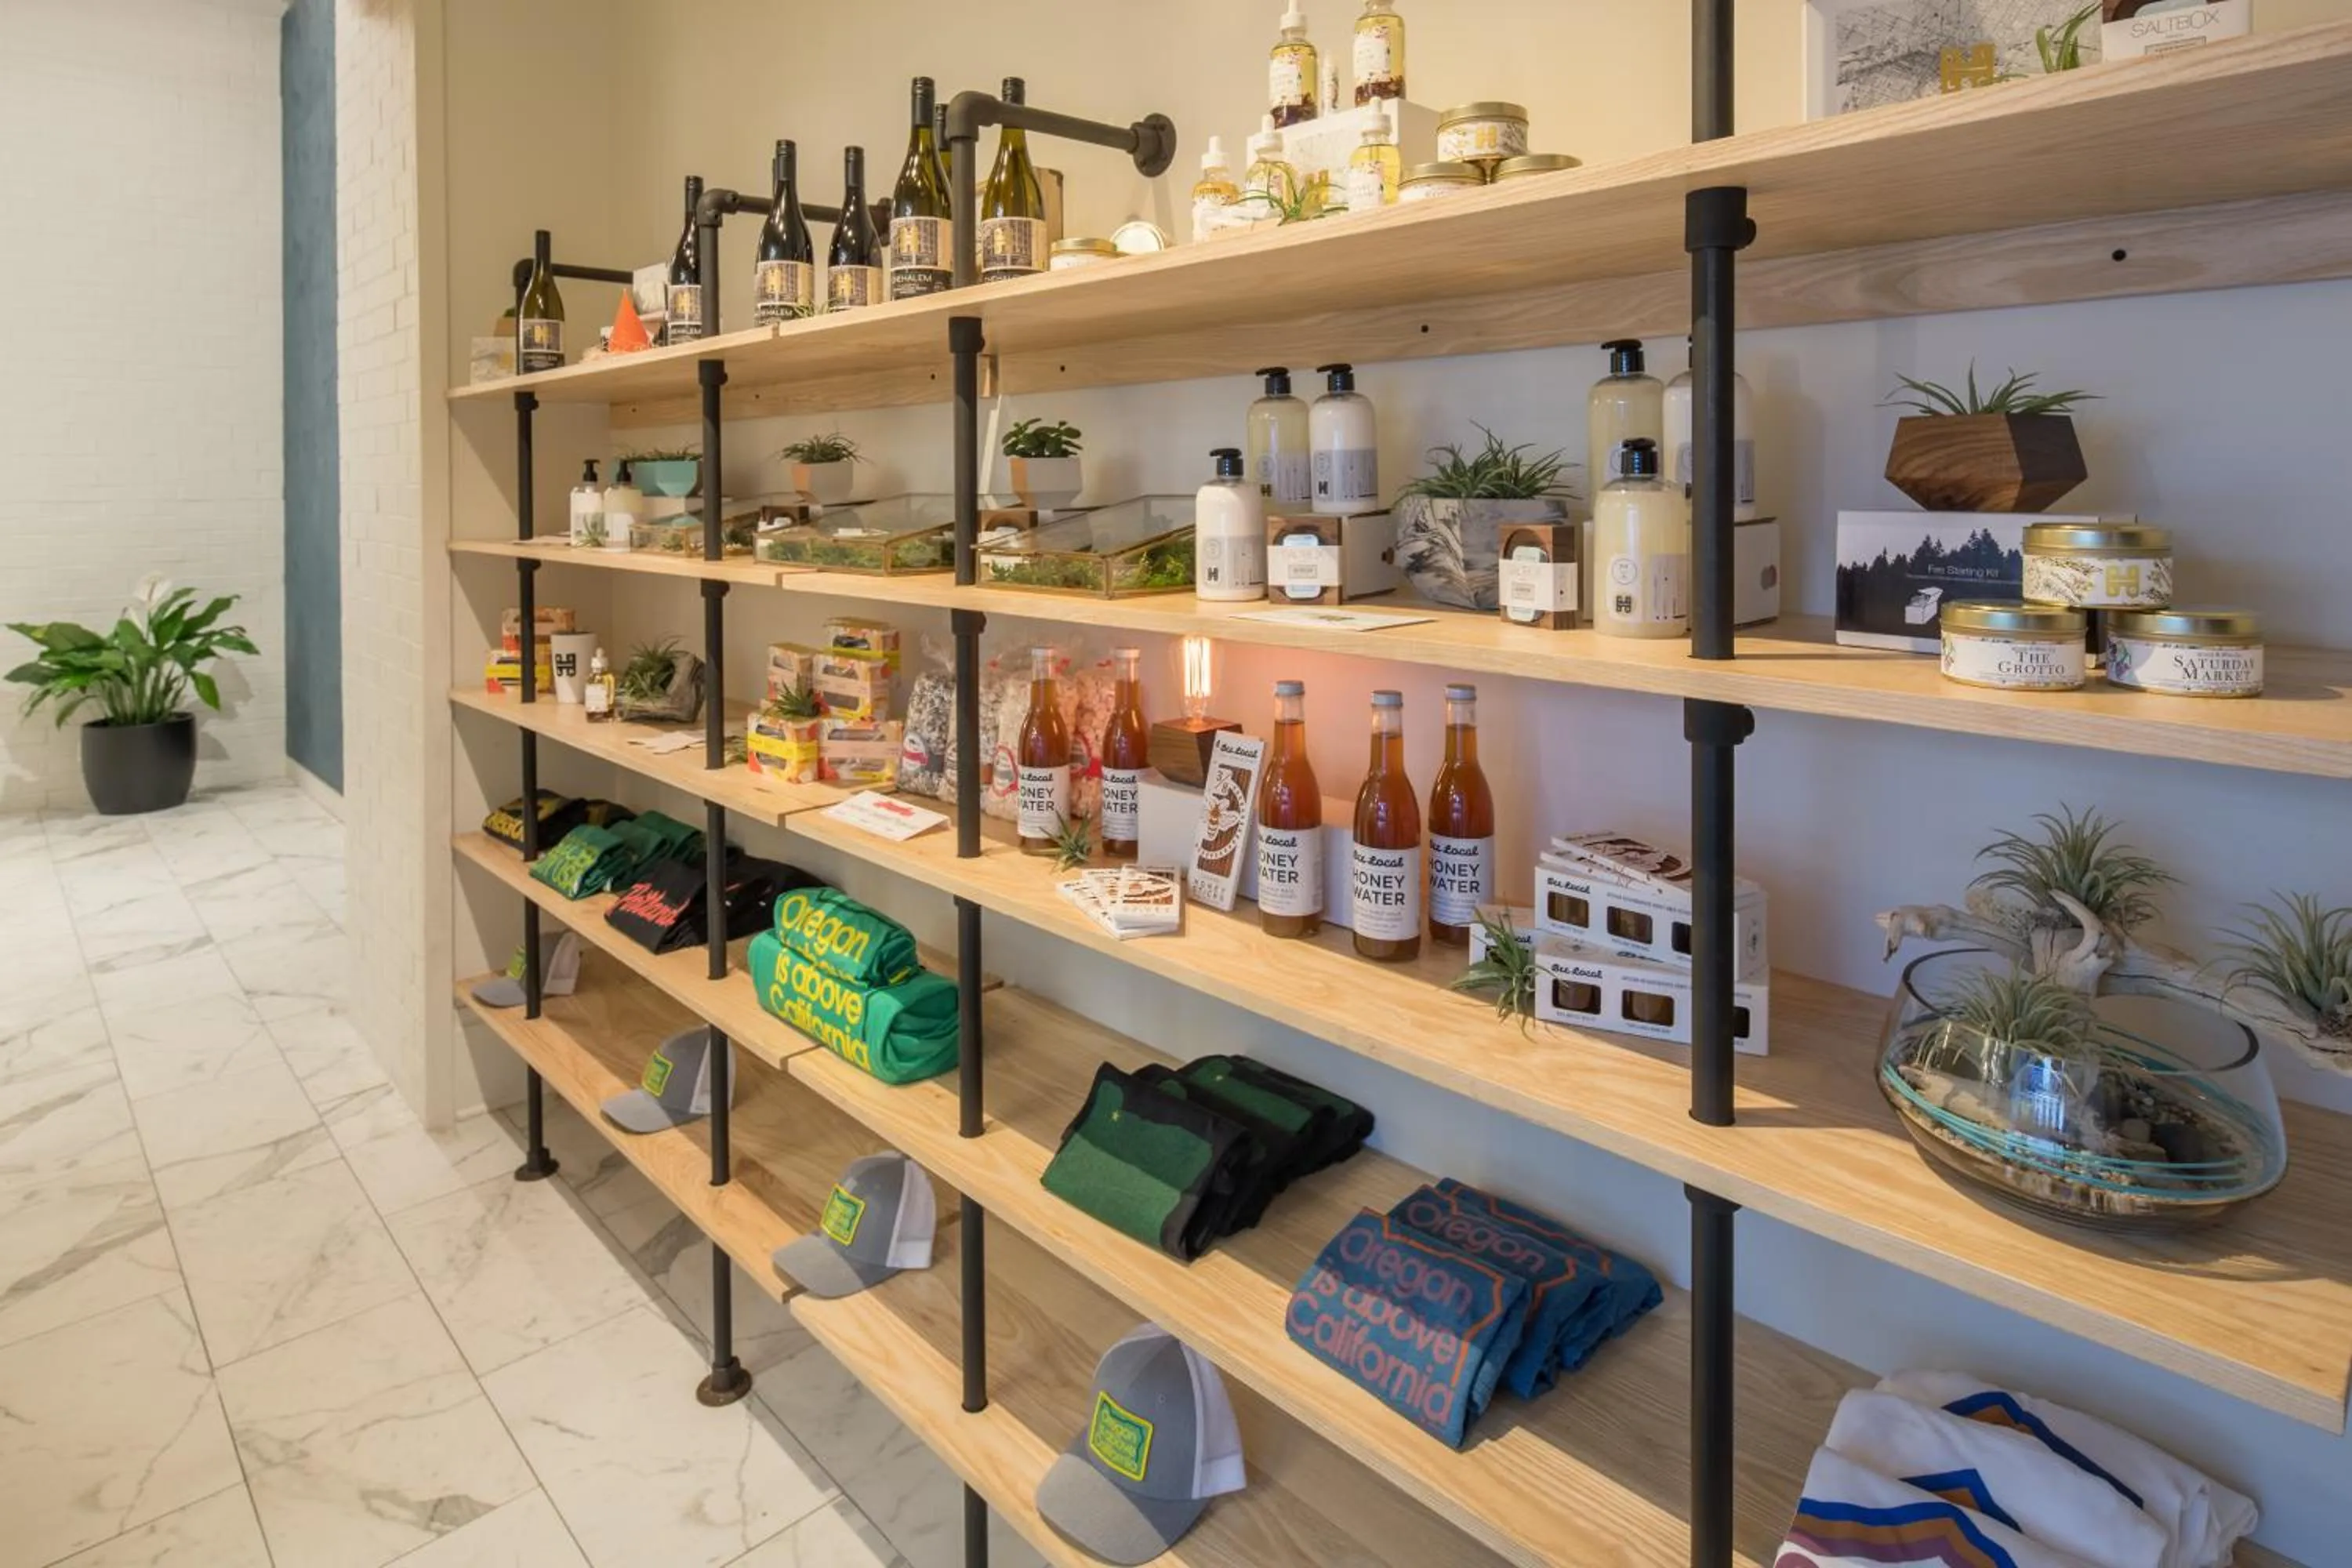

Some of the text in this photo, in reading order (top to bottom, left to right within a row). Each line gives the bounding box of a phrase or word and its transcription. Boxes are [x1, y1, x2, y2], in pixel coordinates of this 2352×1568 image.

[2130, 9, 2220, 38] SALTBOX
[2016, 652, 2050, 664] THE
[2173, 655, 2254, 670] SATURDAY
[1998, 661, 2065, 675] GROTTO
[2183, 667, 2251, 681] MARKET
[1020, 787, 1054, 799] ONEY
[1103, 789, 1138, 800] ONEY
[1021, 800, 1054, 811] ATER
[1103, 802, 1138, 814] ATER
[1259, 848, 1298, 868] ONEY
[782, 893, 869, 964] Oregon
[1551, 964, 1570, 975] Bee
[1408, 1200, 1547, 1275] Oregon
[1339, 1227, 1474, 1316] Oregon
[1341, 1283, 1457, 1366] above
[1290, 1290, 1456, 1425] California
